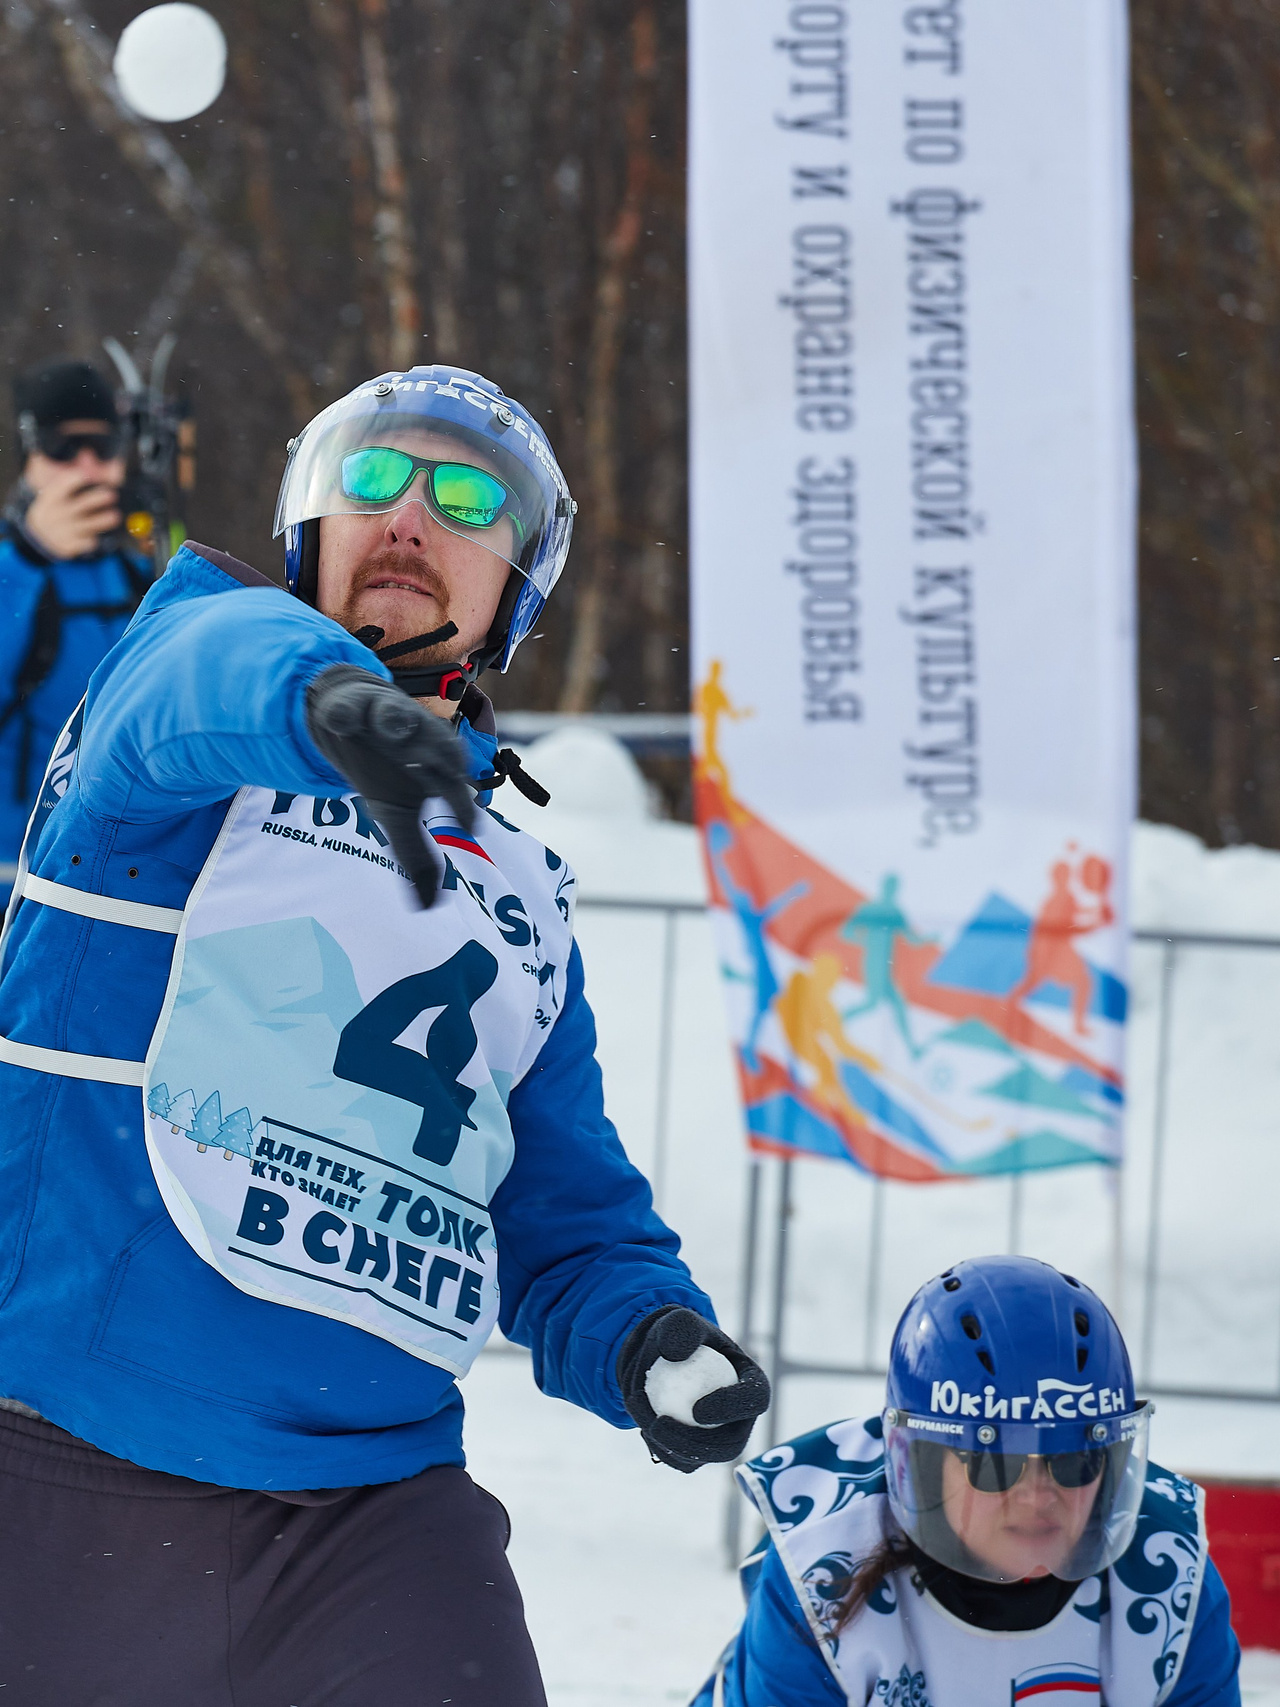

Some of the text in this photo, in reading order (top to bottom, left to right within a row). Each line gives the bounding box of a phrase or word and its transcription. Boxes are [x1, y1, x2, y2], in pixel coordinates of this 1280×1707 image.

[774, 0, 864, 724] орту и охране здоровья
[889, 0, 984, 850] ет по физической культуре,
[261, 821, 395, 872] RUSSIA, MURMANSK
[333, 938, 499, 1166] 4
[251, 1160, 361, 1212] КТО ЗНАЕТ
[255, 1136, 367, 1193] ДЛЯ ТЕХ,
[236, 1186, 484, 1325] В СНЕГЕ
[377, 1181, 489, 1265] ТОЛК
[907, 1418, 964, 1434] МУРМАНСК
